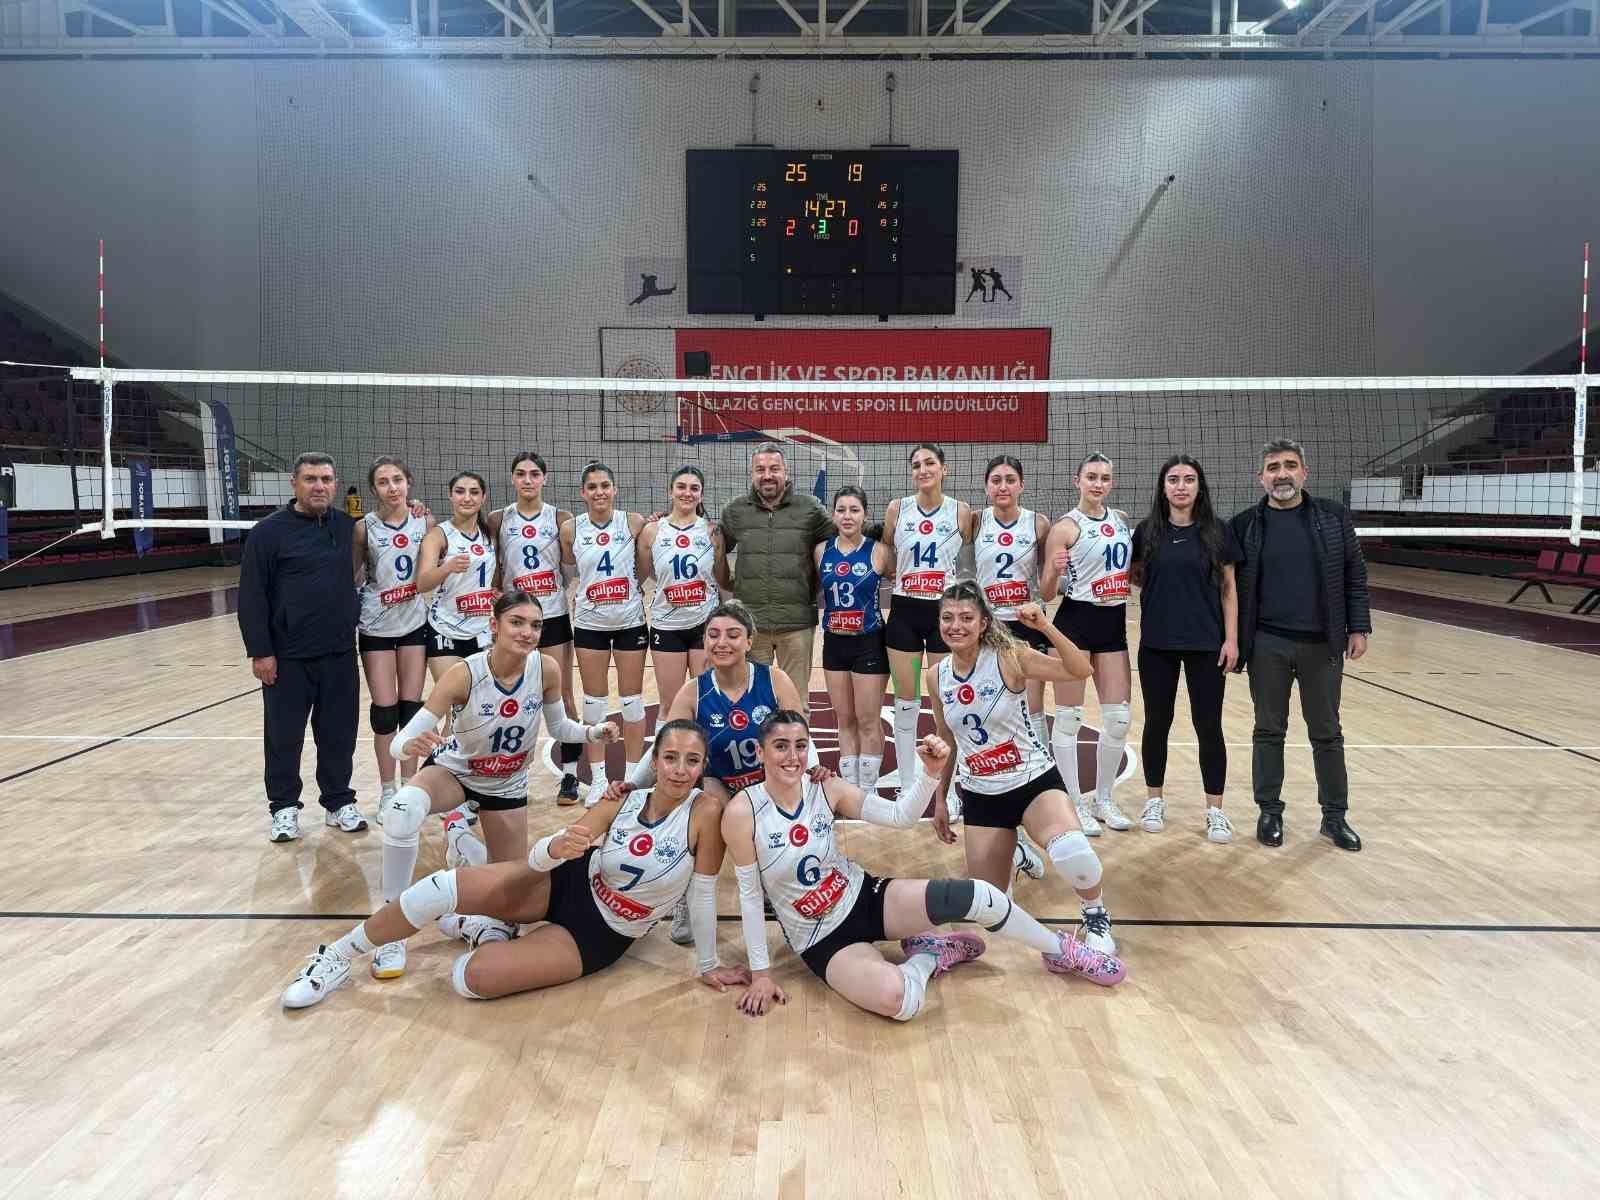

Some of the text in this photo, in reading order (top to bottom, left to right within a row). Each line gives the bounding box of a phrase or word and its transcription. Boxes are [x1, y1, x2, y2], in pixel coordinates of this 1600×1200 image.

[786, 164, 807, 181] 25
[848, 164, 863, 181] 19
[757, 218, 767, 226] 25
[786, 219, 796, 235] 2
[819, 219, 827, 233] 3
[848, 219, 858, 235] 0
[762, 395, 828, 414] GENÇLİK
[831, 398, 850, 411] VE
[855, 398, 896, 411] SPOR
[900, 395, 912, 411] İL
[916, 395, 1019, 412] MÜDÜRLÜĞÜ
[522, 545, 540, 570] 8
[596, 551, 615, 576] 4
[669, 554, 698, 580] 16
[910, 541, 938, 568] 14
[995, 552, 1014, 579] 2
[1102, 542, 1128, 572] 10
[394, 555, 413, 581] 9
[476, 561, 486, 587] 1
[589, 582, 627, 600] gülpaş
[667, 585, 704, 602] gülpaş
[829, 582, 854, 607] 13
[903, 573, 943, 591] gülpaş
[988, 583, 1028, 602] gülpaş
[434, 636, 454, 650] 14
[489, 725, 525, 753] 18
[962, 713, 989, 746] 3
[724, 738, 762, 770] 19
[618, 863, 645, 892] 7
[796, 855, 821, 886] 6
